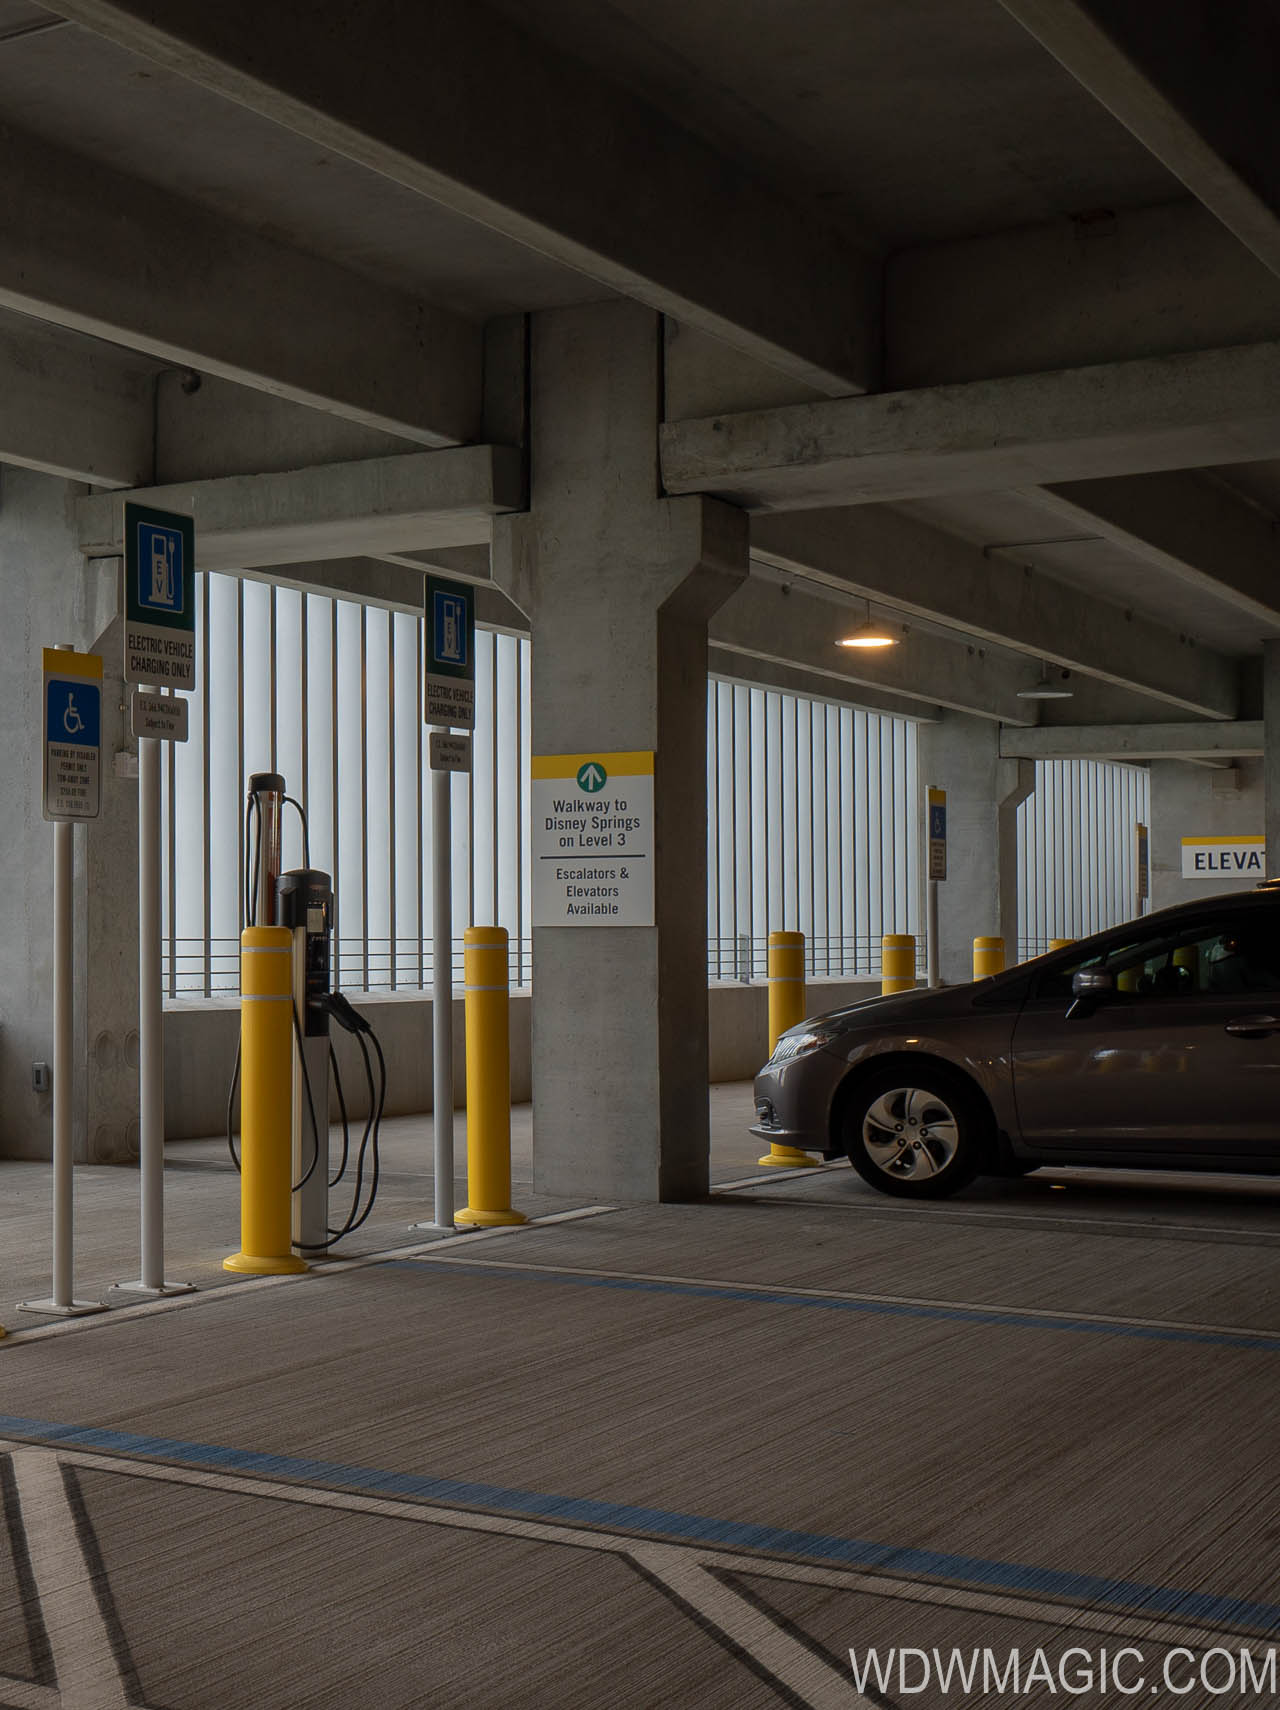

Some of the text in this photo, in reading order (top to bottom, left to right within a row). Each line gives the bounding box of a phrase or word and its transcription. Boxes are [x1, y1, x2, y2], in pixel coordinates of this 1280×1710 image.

[128, 633, 193, 659] ELECTRIC VEHICLE
[130, 655, 191, 678] CHARGING ONLY
[427, 682, 473, 704] ELECTRIC VEHICLE
[429, 700, 457, 718] CHARGING
[552, 798, 627, 814] Walkway to
[545, 815, 641, 832] Disney Springs
[559, 832, 626, 847] on Level 3
[556, 867, 630, 880] Escalators &
[566, 885, 619, 897] Elevators
[566, 903, 619, 915] Available
